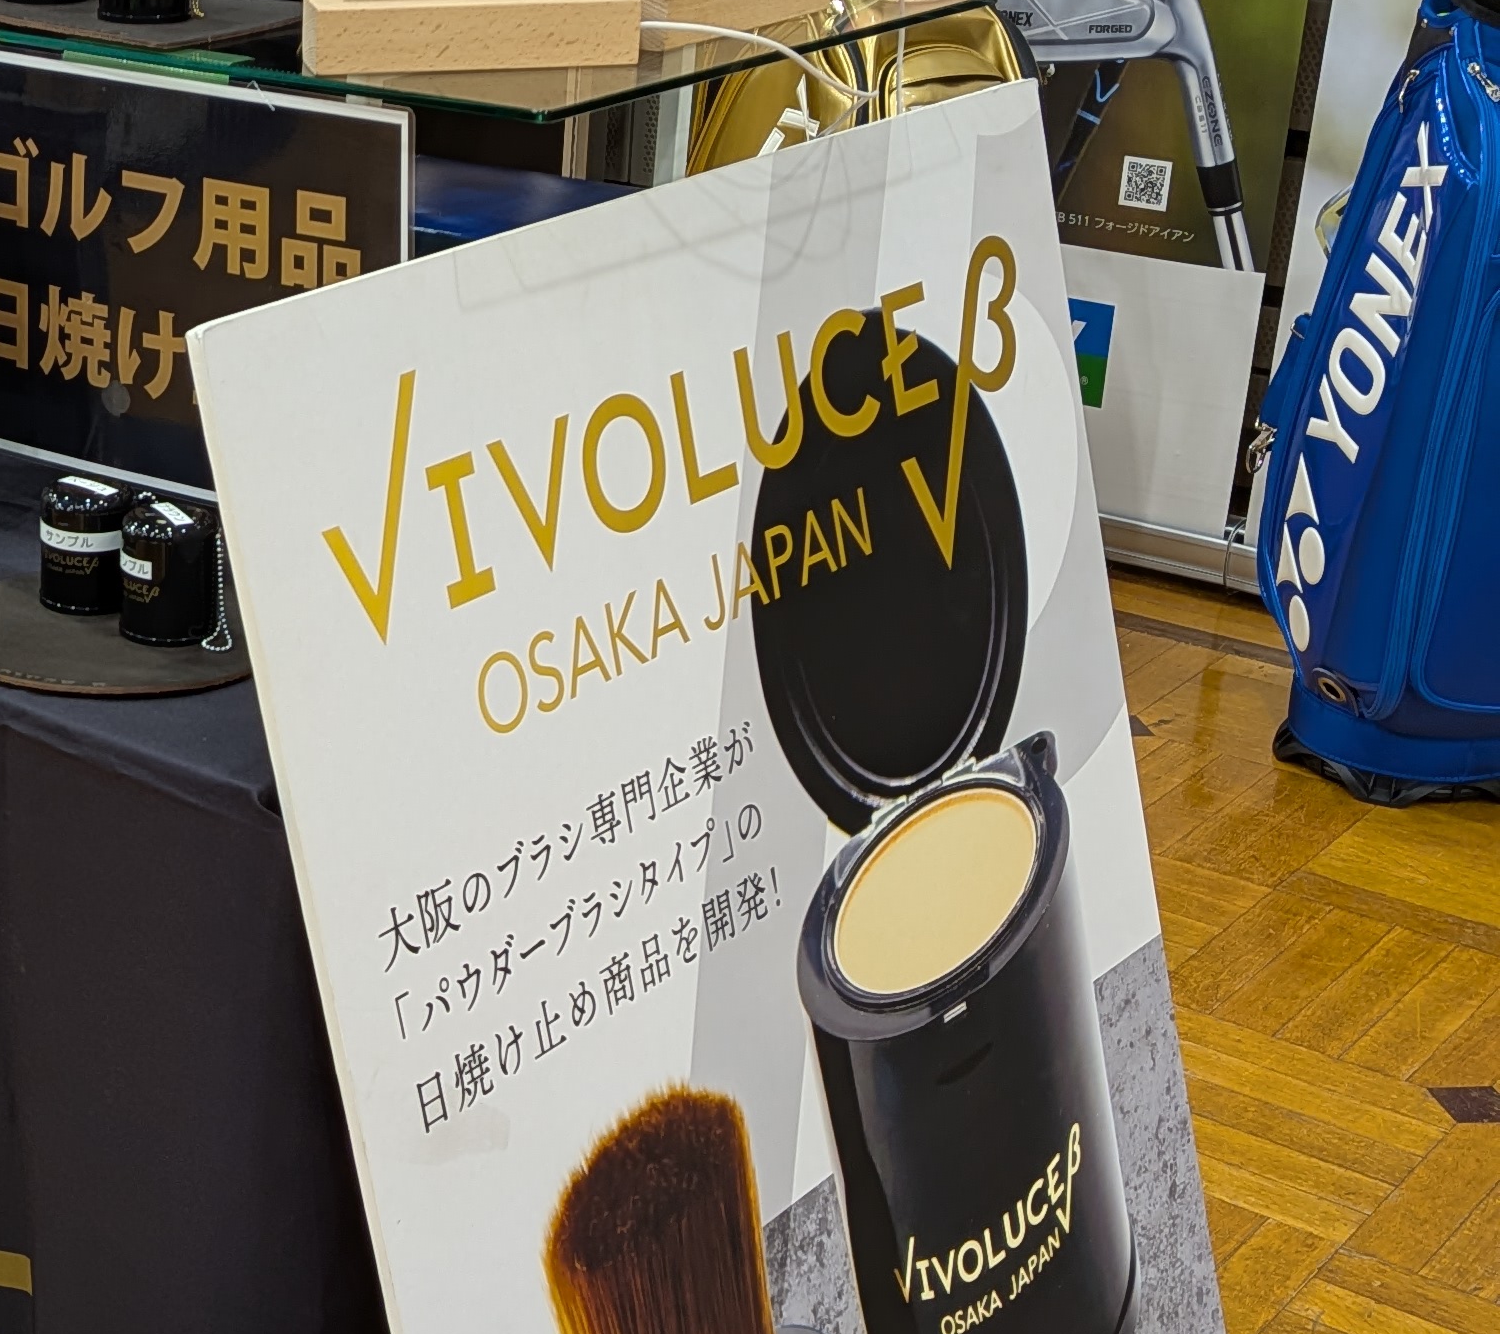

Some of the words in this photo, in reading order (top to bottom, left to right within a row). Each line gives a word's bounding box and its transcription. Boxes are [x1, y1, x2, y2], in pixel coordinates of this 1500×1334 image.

[1088, 24, 1133, 34] FORGED
[1201, 75, 1223, 147] EZONE
[1068, 213, 1090, 227] 511
[1094, 217, 1195, 243] フォージドアイアン
[1306, 121, 1449, 464] YONEX
[45, 530, 94, 549] サンプル
[477, 578, 690, 734] OSAKA
[702, 487, 874, 634] JAPAN
[378, 721, 754, 973] 大阪のブラシ専門企業が
[395, 803, 763, 1040] 「パウダーブラシタイプ」の
[1009, 1234, 1061, 1301] JAPAN
